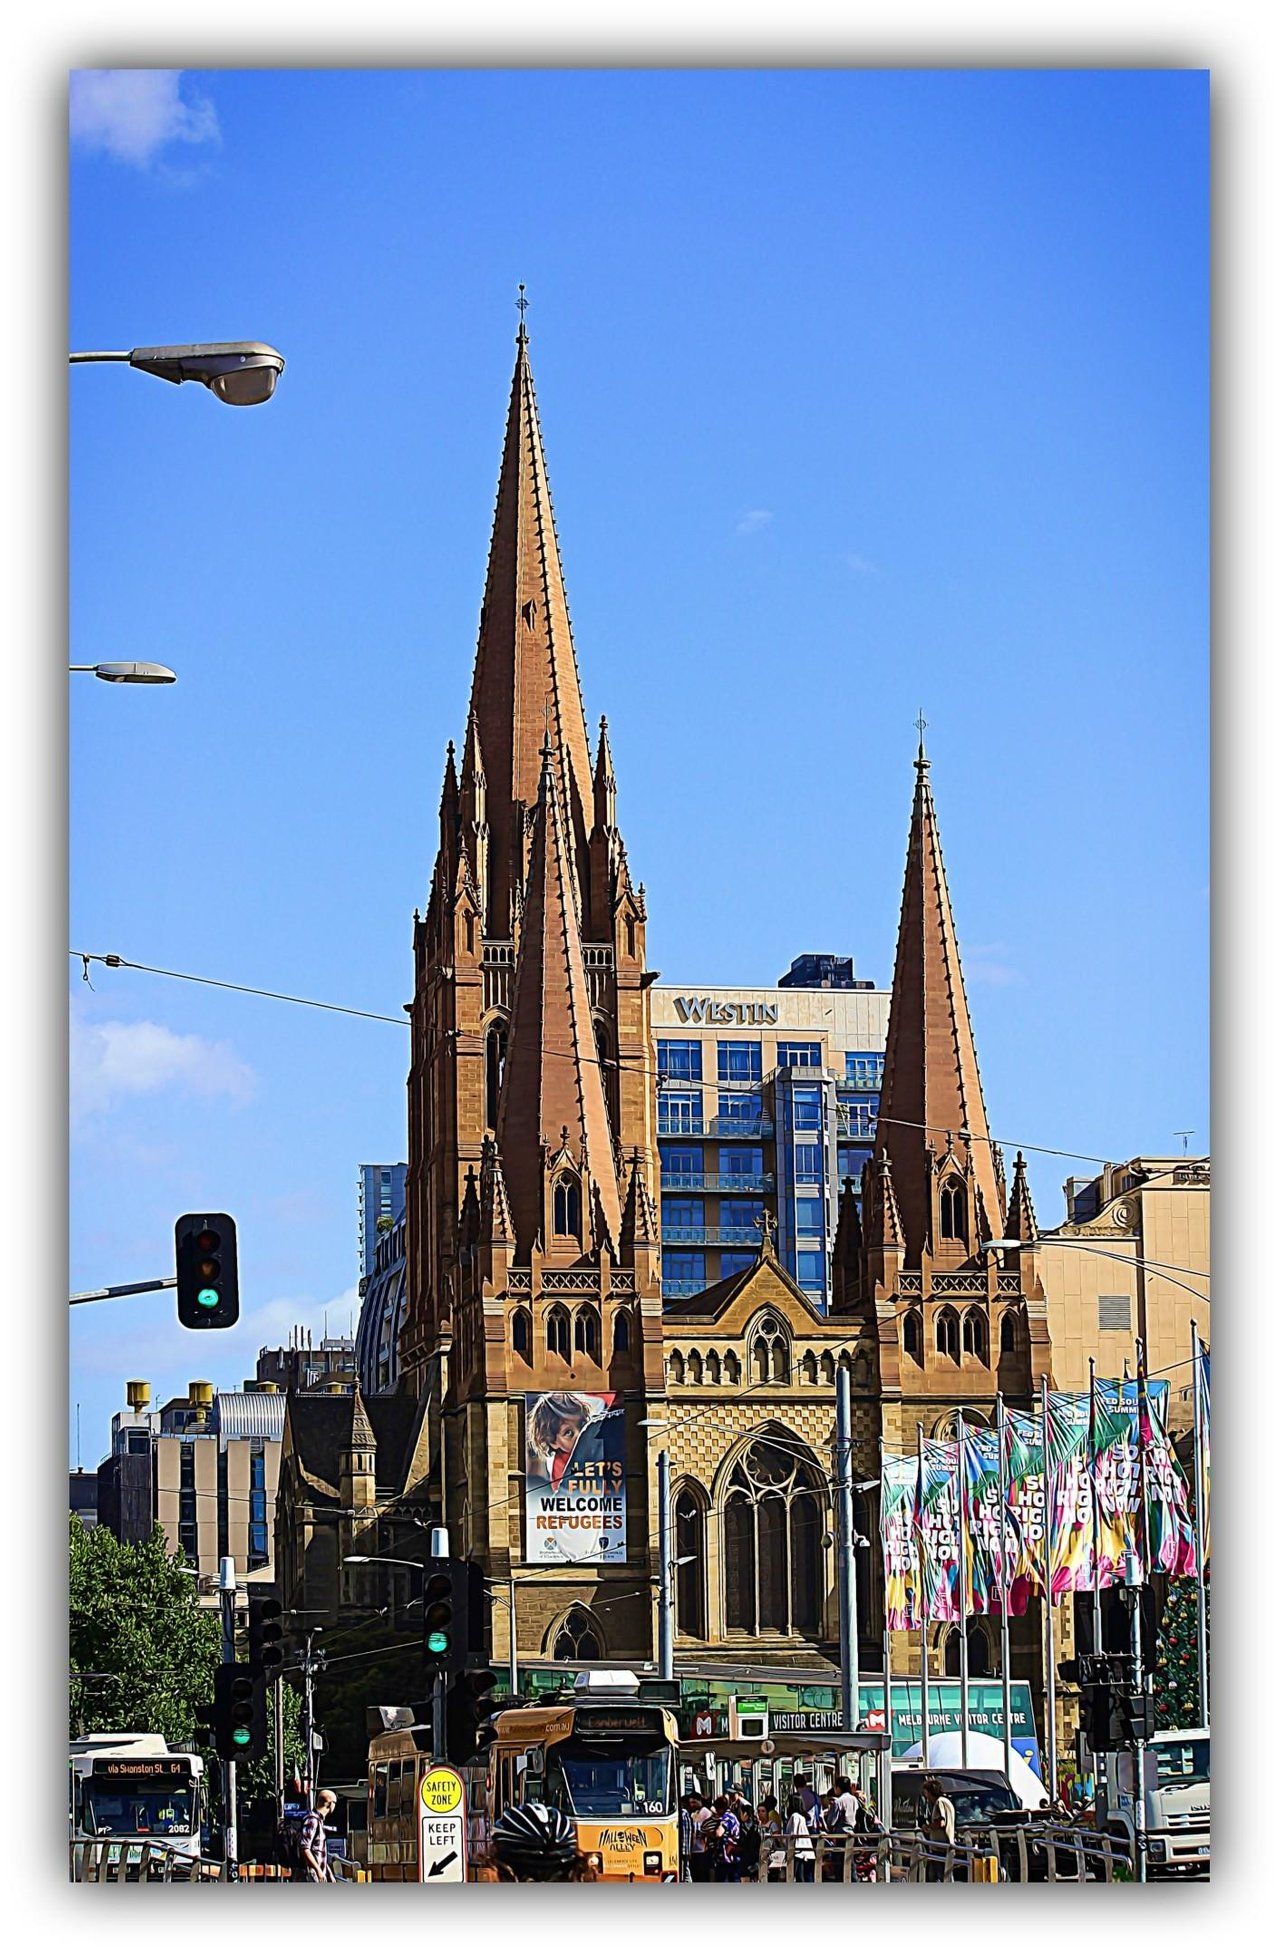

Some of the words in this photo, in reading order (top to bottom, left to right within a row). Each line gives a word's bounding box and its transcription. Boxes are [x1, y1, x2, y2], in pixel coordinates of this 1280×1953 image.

[673, 997, 779, 1026] WESTIN
[1112, 1444, 1138, 1460] SO
[574, 1461, 622, 1476] LET'S
[568, 1480, 622, 1495] FULLY
[541, 1497, 623, 1512] WELCOME
[1018, 1491, 1046, 1508] HO
[536, 1514, 623, 1530] REFUGEES
[774, 1714, 806, 1730] VISITOR
[810, 1712, 844, 1728] CENTRE
[898, 1714, 951, 1726] MELBURNE
[954, 1712, 988, 1724] VIITOR
[992, 1712, 1026, 1724] CETRE
[108, 1764, 119, 1774] via
[120, 1763, 154, 1774] Swanston
[154, 1763, 164, 1774] St
[170, 1763, 181, 1774] 64
[426, 1781, 456, 1792] SAFETY
[431, 1794, 452, 1806] ZONE
[643, 1801, 663, 1814] 160
[168, 1824, 190, 1834] 2082
[428, 1823, 456, 1834] KEEP
[430, 1836, 456, 1846] LEFT
[598, 1828, 648, 1848] HALLOWEEN
